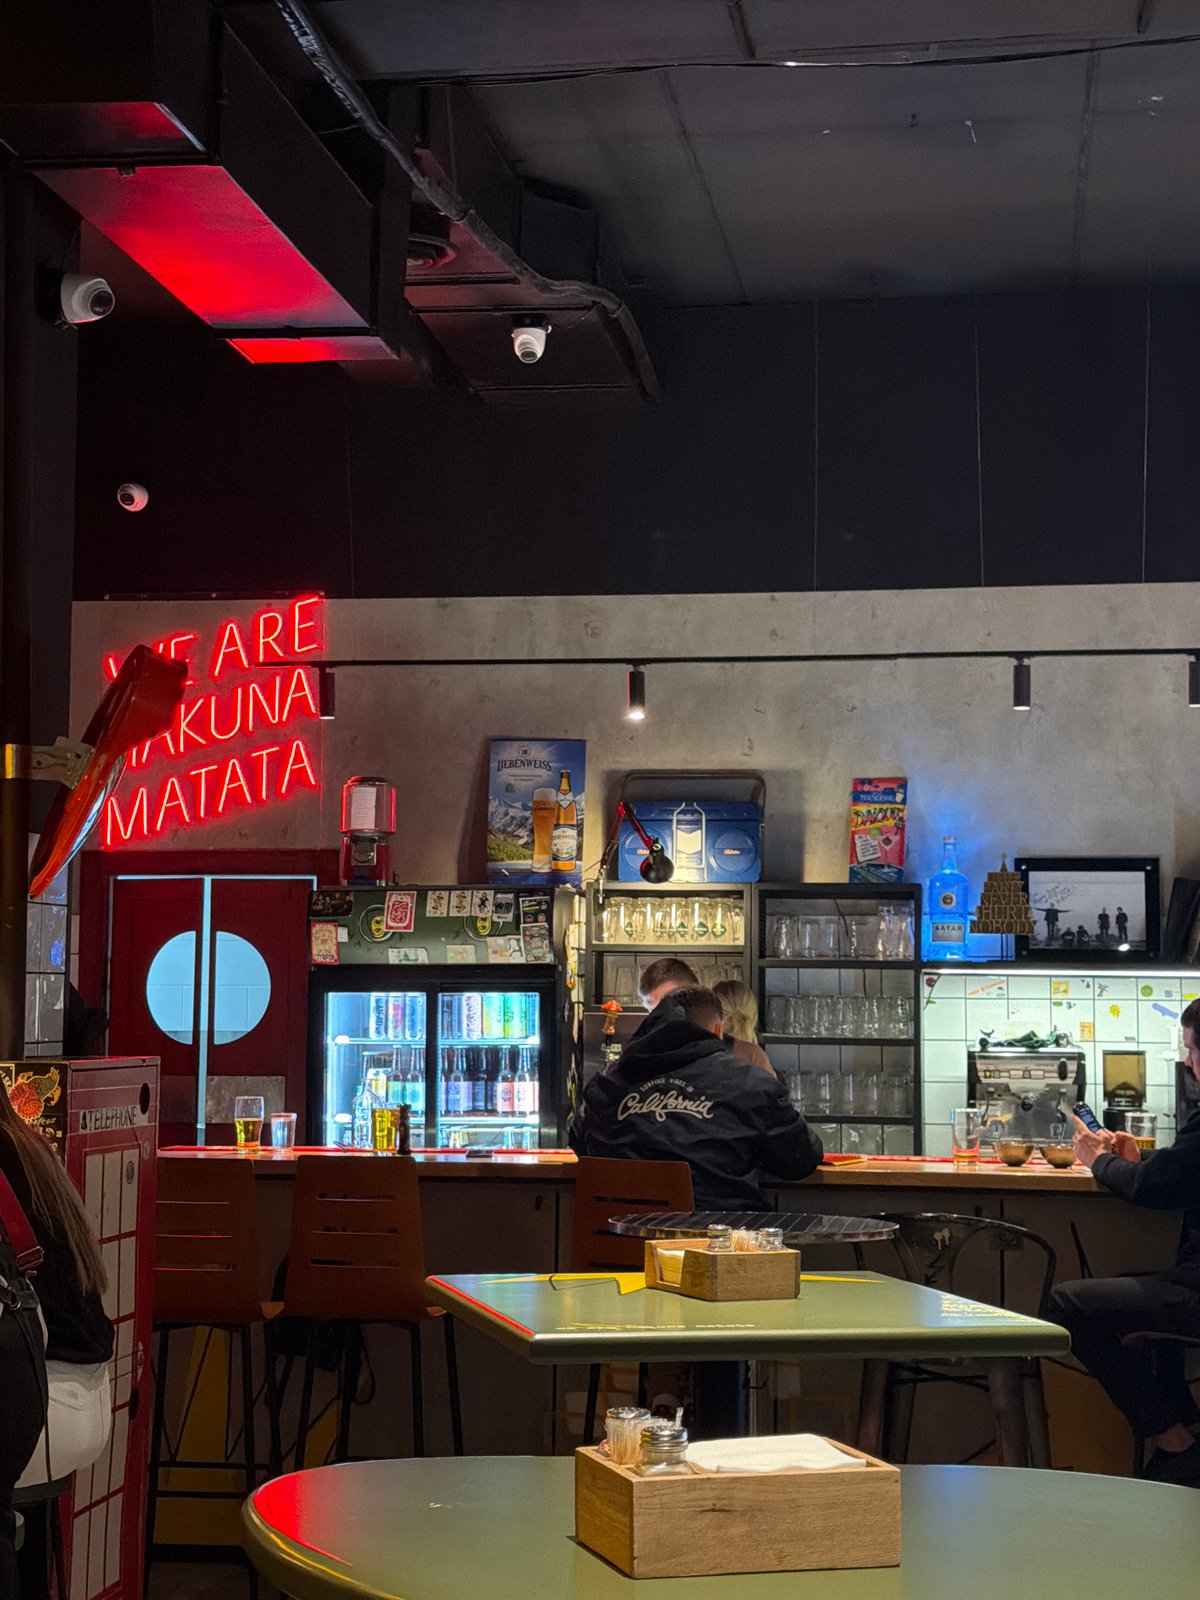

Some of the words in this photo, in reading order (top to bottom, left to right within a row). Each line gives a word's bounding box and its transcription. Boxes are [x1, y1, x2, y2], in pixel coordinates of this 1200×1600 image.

[213, 596, 320, 677] ARE
[128, 667, 318, 768] KUNA
[105, 739, 317, 847] MATATA
[970, 919, 1038, 934] NOBODY
[88, 1106, 138, 1132] TELEPHONE
[617, 1090, 714, 1122] California
